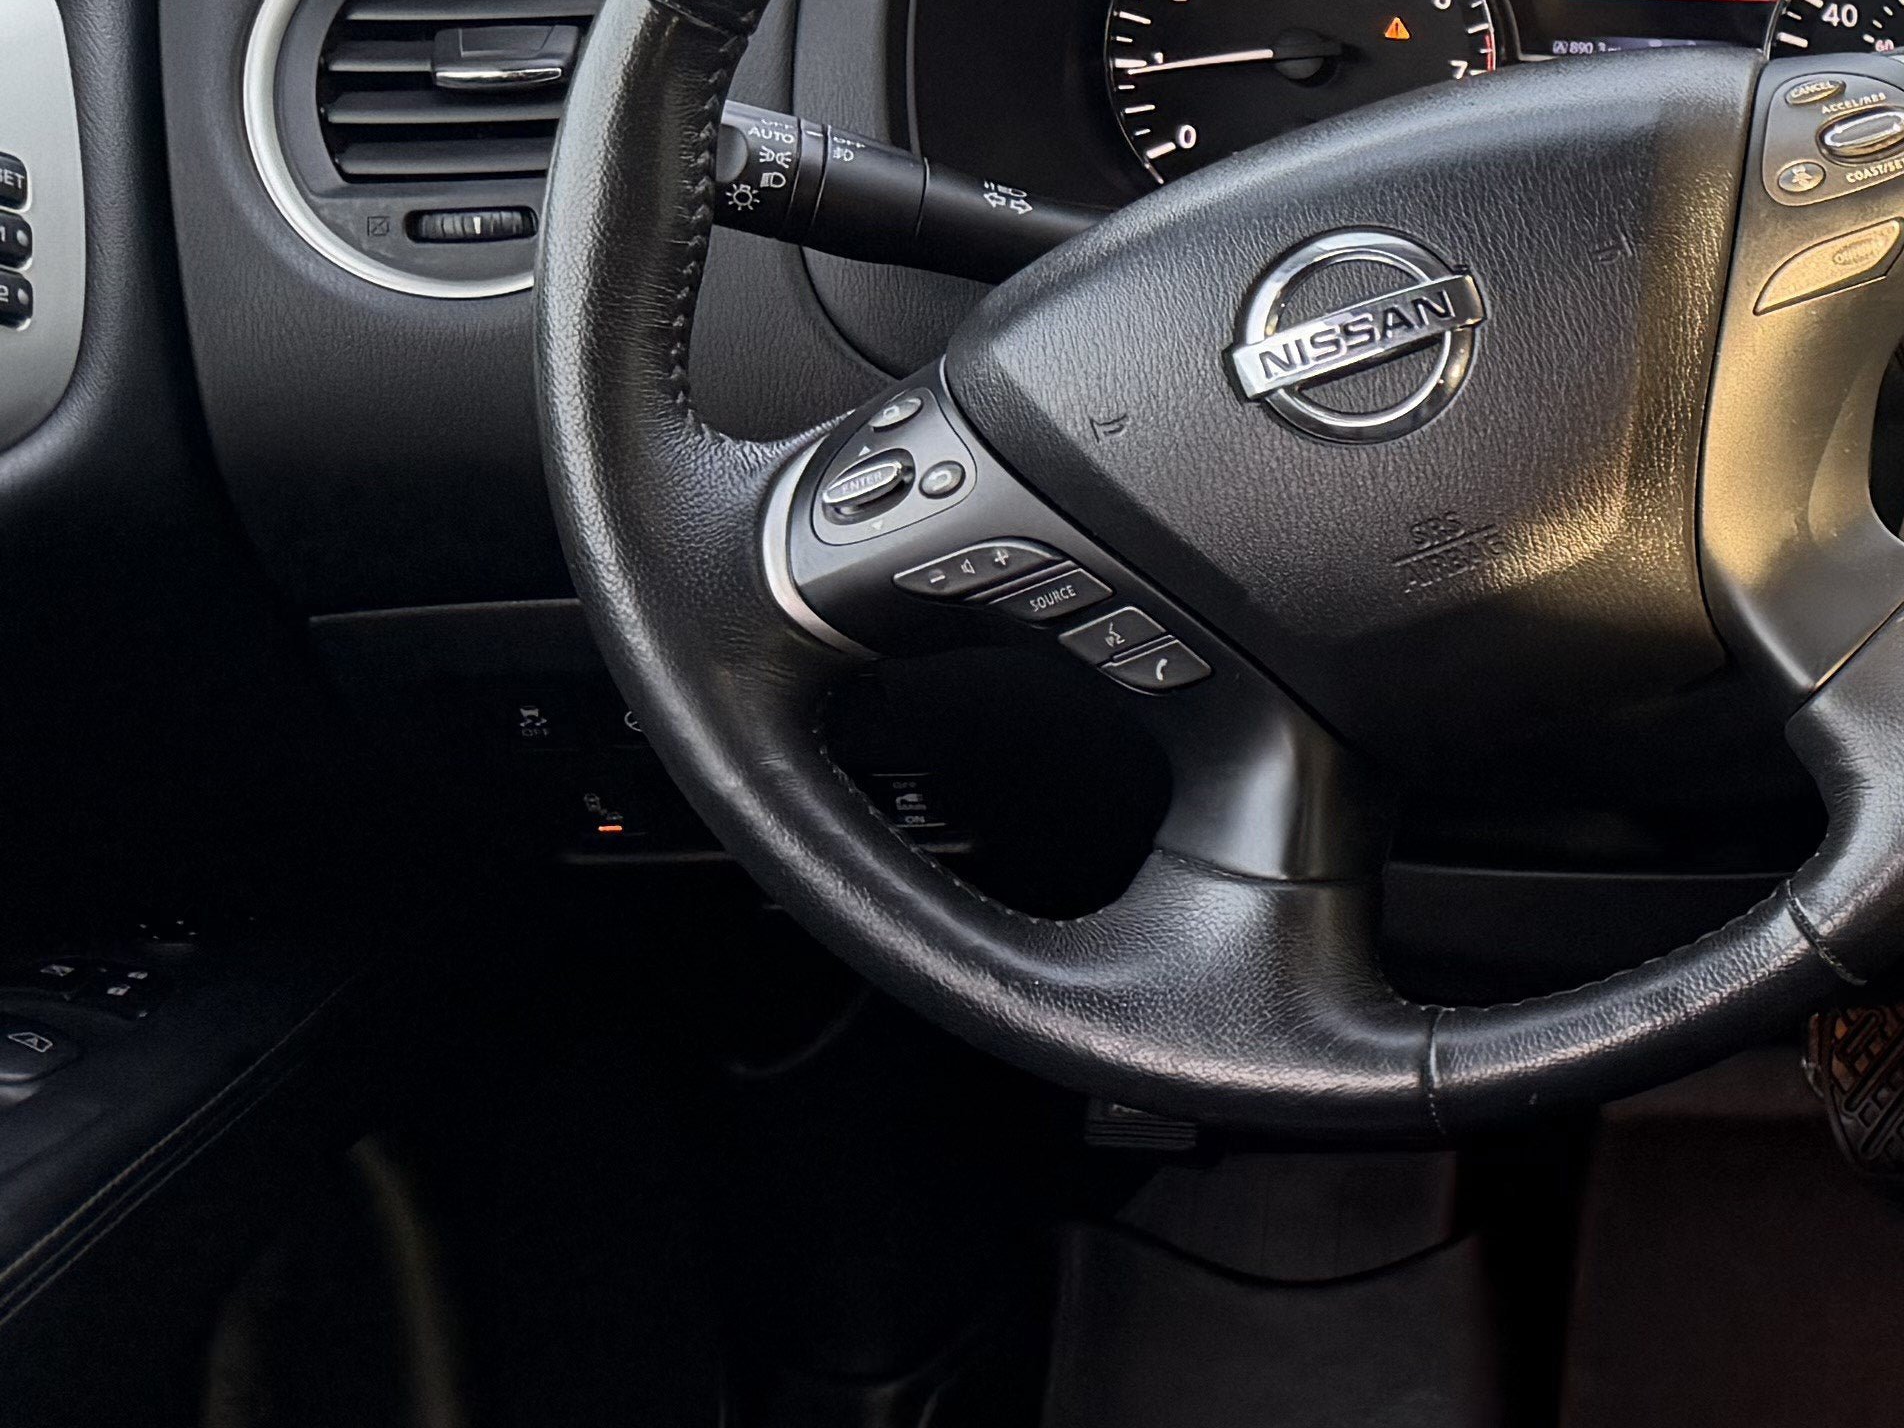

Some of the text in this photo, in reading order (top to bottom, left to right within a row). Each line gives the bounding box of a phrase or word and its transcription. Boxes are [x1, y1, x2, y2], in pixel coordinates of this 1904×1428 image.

[1822, 3, 1858, 27] 40
[1449, 60, 1468, 79] 7
[1791, 80, 1833, 98] CANCEL
[748, 126, 795, 144] AUTO
[1177, 125, 1196, 149] 0
[1258, 290, 1456, 380] NISSAN
[842, 472, 882, 494] ENTER
[1030, 584, 1077, 612] SOURCE
